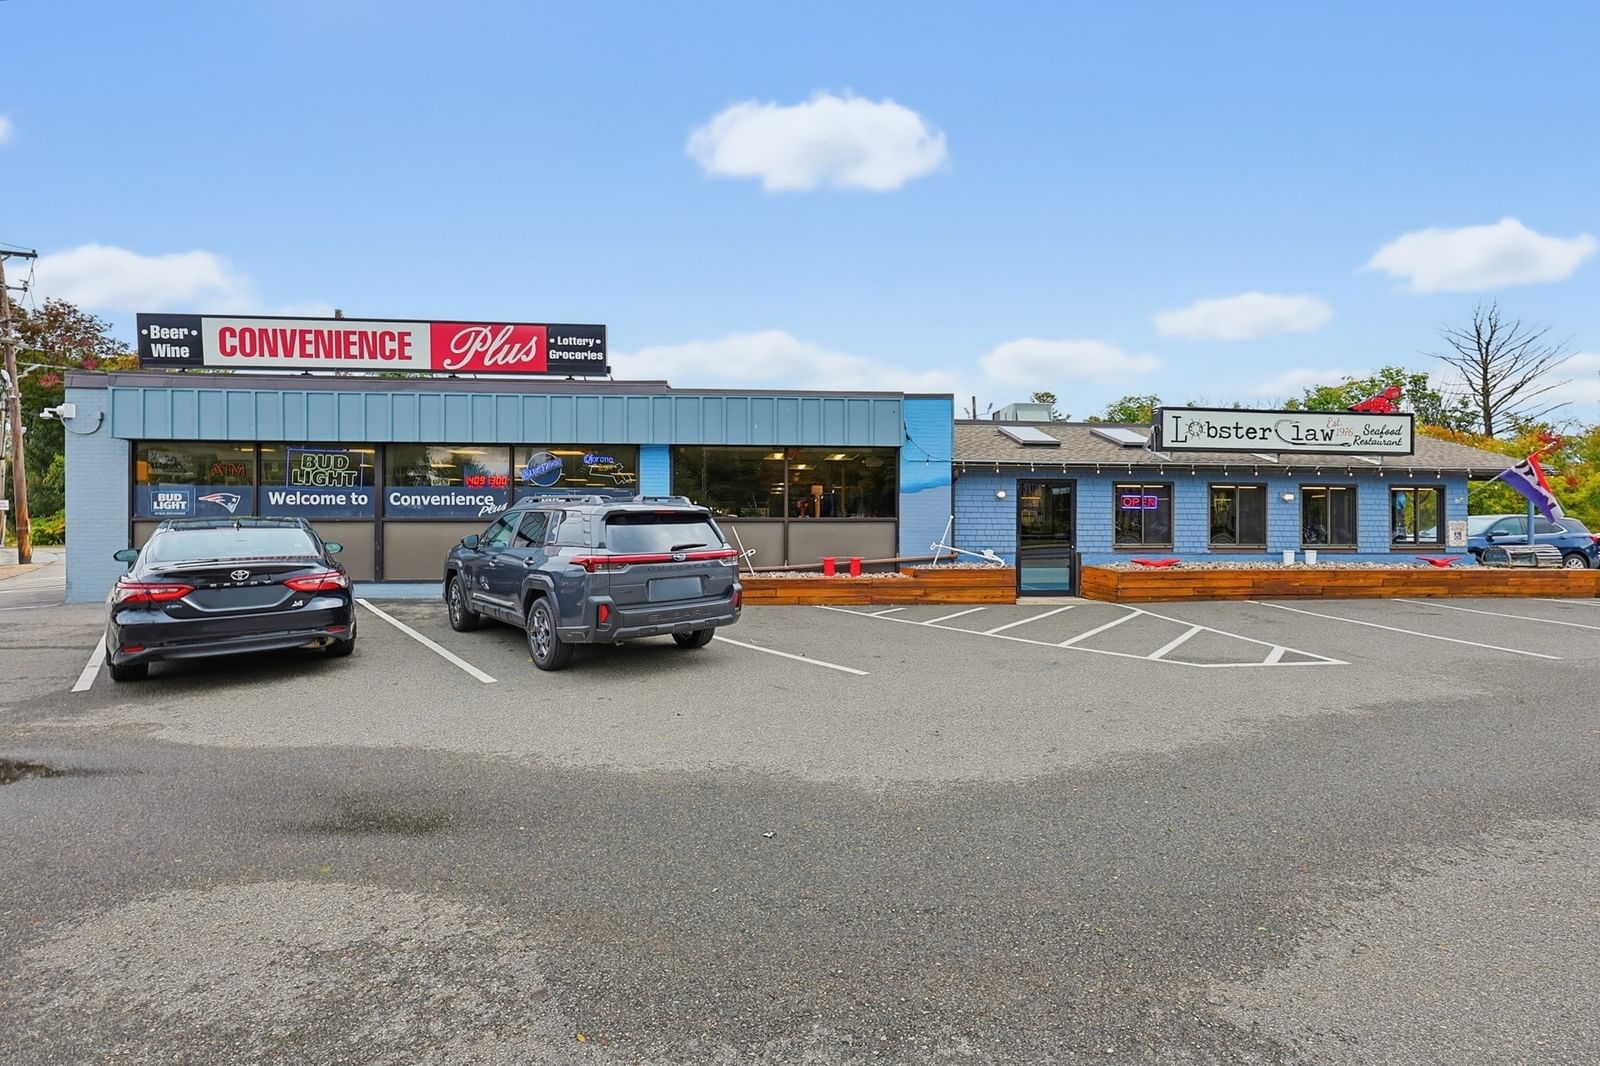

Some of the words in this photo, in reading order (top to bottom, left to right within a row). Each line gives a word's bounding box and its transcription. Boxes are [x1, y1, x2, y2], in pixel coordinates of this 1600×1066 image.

[149, 325, 189, 339] Beer
[218, 326, 413, 361] CONVENIENCE
[443, 324, 538, 370] Plus
[557, 336, 595, 347] Lottery
[151, 343, 190, 358] Wine
[549, 350, 604, 360] Groceries
[1363, 423, 1403, 438] Seafood
[1353, 435, 1403, 447] Restaurant
[301, 453, 350, 471] BUD
[583, 454, 614, 464] Corona
[292, 468, 358, 487] LIGHT
[157, 493, 182, 501] BUD
[268, 491, 346, 505] Welcome
[350, 492, 368, 505] to
[389, 492, 494, 506] Convenience
[1123, 497, 1155, 507] OPEN
[153, 501, 187, 510] LIGHT
